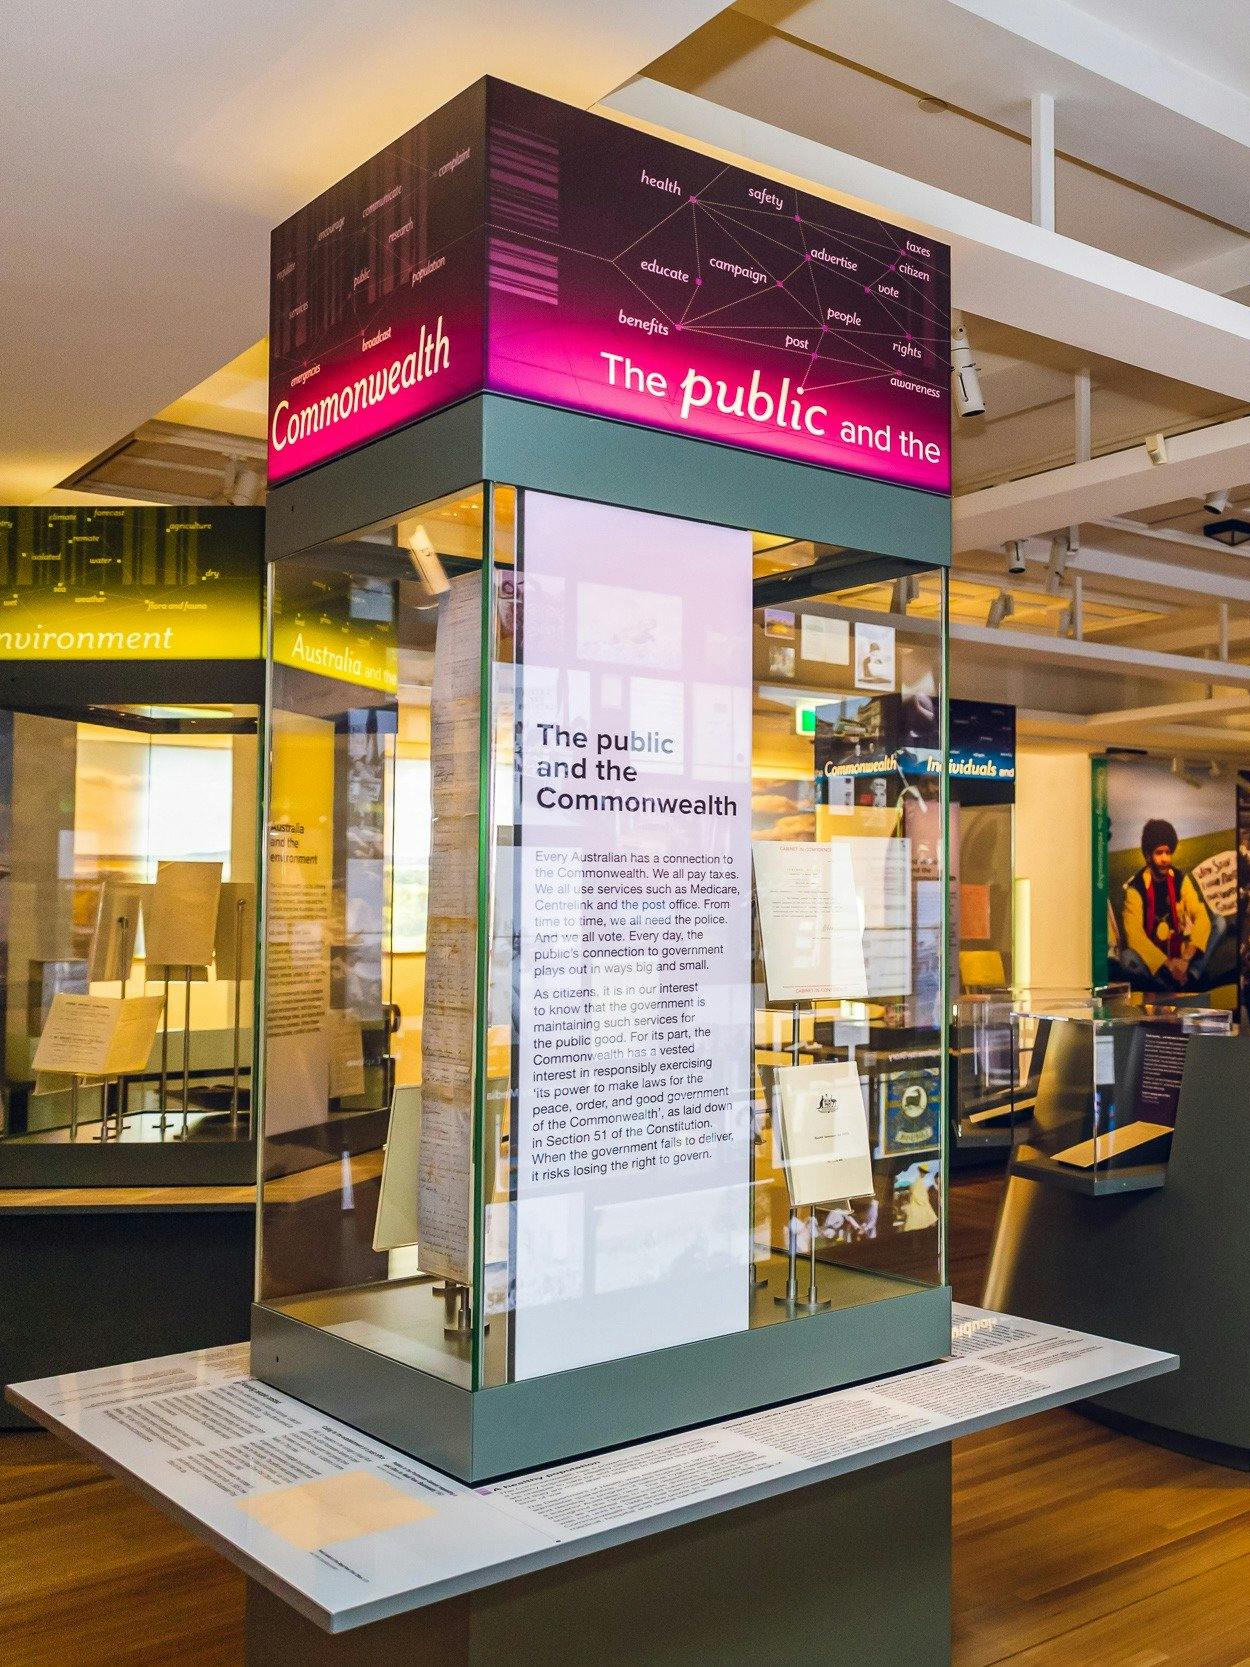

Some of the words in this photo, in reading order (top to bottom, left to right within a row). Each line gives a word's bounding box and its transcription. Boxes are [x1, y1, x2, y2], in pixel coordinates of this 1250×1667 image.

[641, 170, 681, 196] health
[748, 186, 784, 210] safety
[810, 248, 858, 272] advertise
[906, 240, 931, 258] taxes
[640, 258, 690, 283] educate
[710, 256, 767, 284] campaign
[898, 262, 930, 282] citizen
[878, 284, 900, 298] vote
[618, 308, 670, 336] benefits
[826, 307, 862, 326] people
[362, 326, 392, 352] broadcast
[786, 334, 810, 350] post
[892, 340, 922, 360] rights
[272, 316, 450, 451] Commonwealth
[890, 376, 941, 399] awareness
[600, 351, 668, 398] The
[680, 368, 828, 436] public
[840, 420, 890, 452] and
[898, 430, 941, 464] the
[206, 568, 220, 579] dry
[168, 602, 184, 610] and
[291, 632, 362, 676] Australia
[537, 724, 588, 749] The
[597, 729, 674, 756] public
[537, 757, 587, 779] and
[596, 759, 638, 782] the
[824, 754, 898, 778] Commonwealth
[536, 787, 737, 816] Commonwealth
[534, 965, 565, 979] plays
[569, 964, 587, 975] out
[591, 963, 601, 974] in
[605, 964, 633, 976] ways
[636, 961, 653, 975] big
[656, 960, 676, 972] and
[679, 959, 709, 972] small.
[534, 988, 549, 1000] As
[603, 985, 611, 997] it
[614, 985, 623, 996] is
[626, 984, 636, 996] in
[639, 985, 657, 995] our
[660, 982, 698, 994] interest
[534, 1005, 546, 1016] to
[550, 1004, 581, 1015] know
[584, 1002, 606, 1013] that
[609, 1000, 628, 1012] the
[631, 997, 694, 1014] government
[697, 996, 706, 1007] is
[534, 1018, 601, 1032] maintaining
[604, 1015, 631, 1028] such
[634, 1014, 678, 1026] services
[681, 1012, 696, 1024] for
[533, 1037, 552, 1049] the
[556, 1034, 591, 1050] public
[631, 1031, 649, 1042] For
[651, 1029, 664, 1041] its
[695, 1026, 711, 1038] the
[533, 1048, 624, 1065] Commonwealth
[628, 1047, 647, 1059] has
[651, 1048, 657, 1057] a
[660, 1043, 695, 1056] vested
[533, 1068, 577, 1082] interest
[580, 1067, 590, 1078] in
[594, 1062, 657, 1079] responsibly
[660, 1058, 713, 1072] exercising
[554, 1086, 591, 1100] power
[594, 1083, 605, 1094] to
[609, 1079, 639, 1092] make
[642, 1078, 667, 1089] laws
[670, 1075, 684, 1087] for
[687, 1073, 704, 1085] the
[612, 1094, 633, 1107] and
[636, 1091, 664, 1108] good
[668, 1085, 729, 1104] government
[533, 1119, 545, 1131] of
[548, 1118, 566, 1130] the
[668, 1108, 680, 1117] as
[683, 1103, 702, 1116] laid
[705, 1102, 733, 1113] down
[532, 1137, 543, 1148] in
[546, 1132, 591, 1146] Section
[594, 1129, 607, 1141] 51
[612, 1127, 623, 1139] of
[626, 1125, 643, 1138] the
[646, 1119, 713, 1135] Constitution.
[532, 1152, 566, 1164] When
[570, 1148, 588, 1160] the
[592, 1140, 658, 1160] government
[661, 1136, 683, 1149] fails
[685, 1136, 696, 1146] to
[532, 1170, 539, 1181] it
[543, 1166, 570, 1180] risks
[574, 1162, 607, 1176] losing
[611, 1159, 629, 1171] the
[632, 1155, 657, 1170] right
[660, 1154, 670, 1165] to
[674, 1150, 712, 1166] govern.
